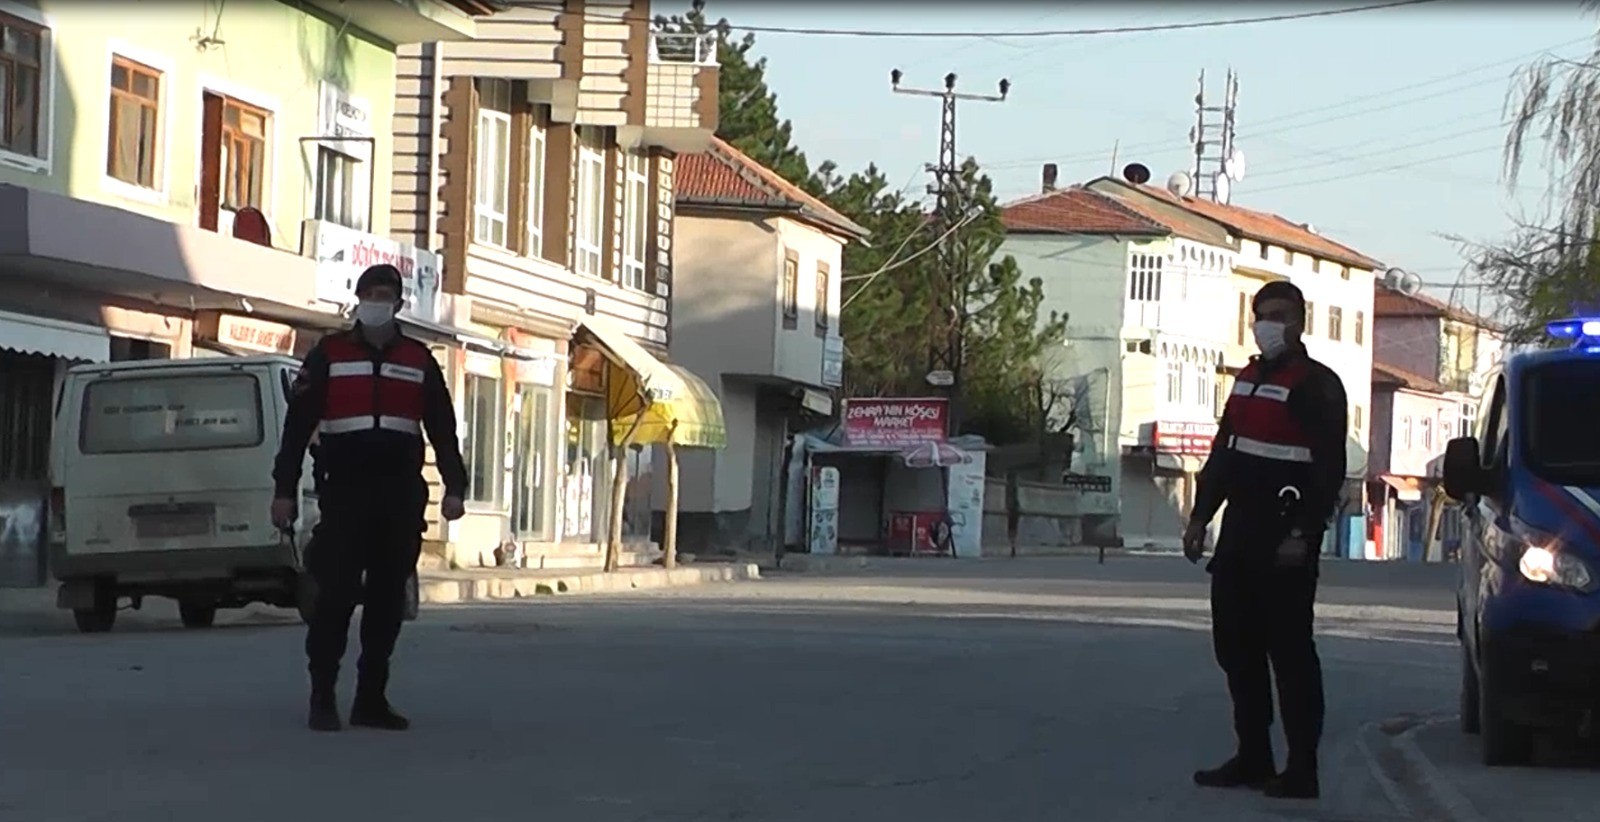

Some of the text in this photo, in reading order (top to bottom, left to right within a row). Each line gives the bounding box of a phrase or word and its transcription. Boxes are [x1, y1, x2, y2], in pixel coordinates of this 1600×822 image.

[848, 404, 940, 420] ZEHRA'NIN KÖŞESİ
[874, 417, 914, 428] MARKET
